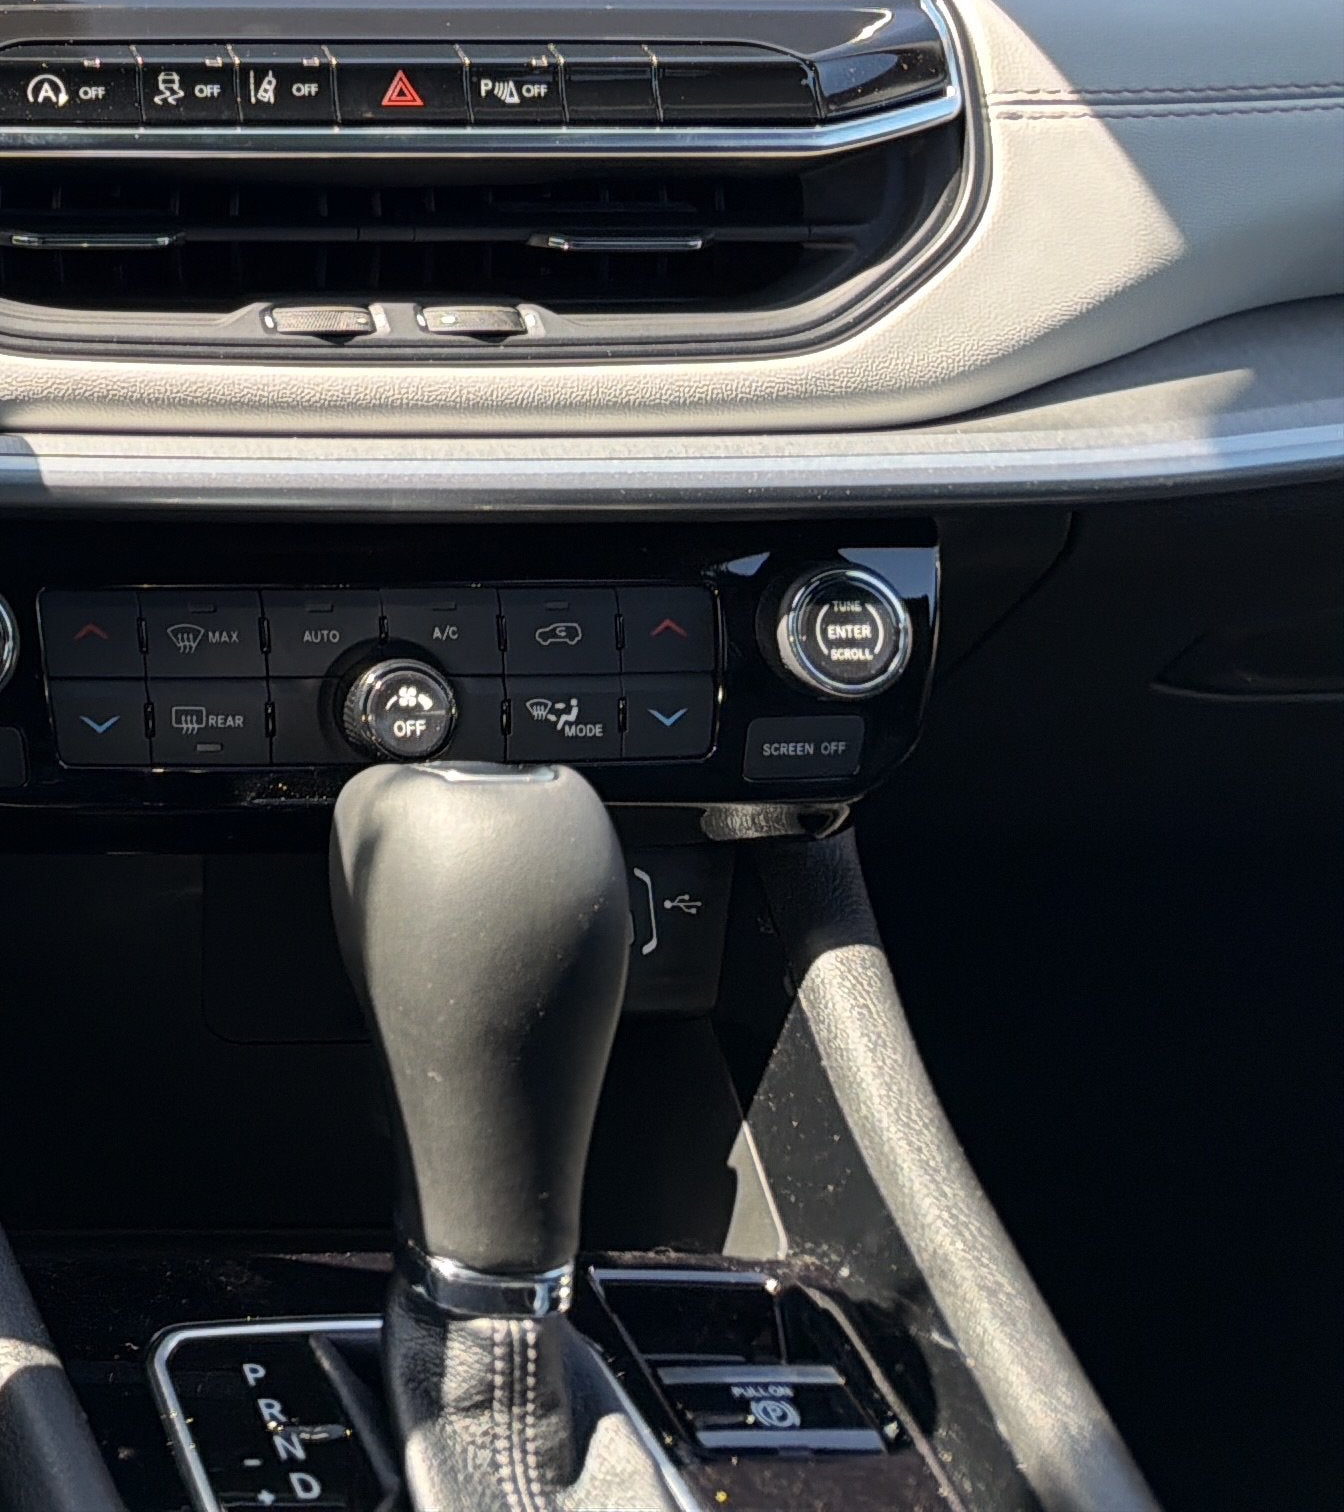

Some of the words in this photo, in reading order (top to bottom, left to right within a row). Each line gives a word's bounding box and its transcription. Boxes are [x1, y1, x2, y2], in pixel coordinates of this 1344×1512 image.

[78, 86, 106, 101] OFF
[194, 84, 221, 99] OFF
[291, 83, 319, 98] OFF
[521, 84, 549, 98] OFF
[831, 599, 863, 612] TUNE
[208, 630, 239, 644] MAX
[302, 629, 340, 644] AUTO
[432, 625, 459, 640] A/C
[826, 623, 873, 640] ENTER
[830, 646, 874, 662] SCROLL
[208, 714, 244, 729] REAR
[392, 719, 427, 738] OFF
[564, 723, 604, 738] MODE
[762, 741, 814, 757] SCREEN
[820, 740, 846, 756] OFF
[243, 1363, 267, 1387] P
[257, 1398, 289, 1425] R
[272, 1432, 307, 1462] N
[289, 1471, 323, 1500] D
